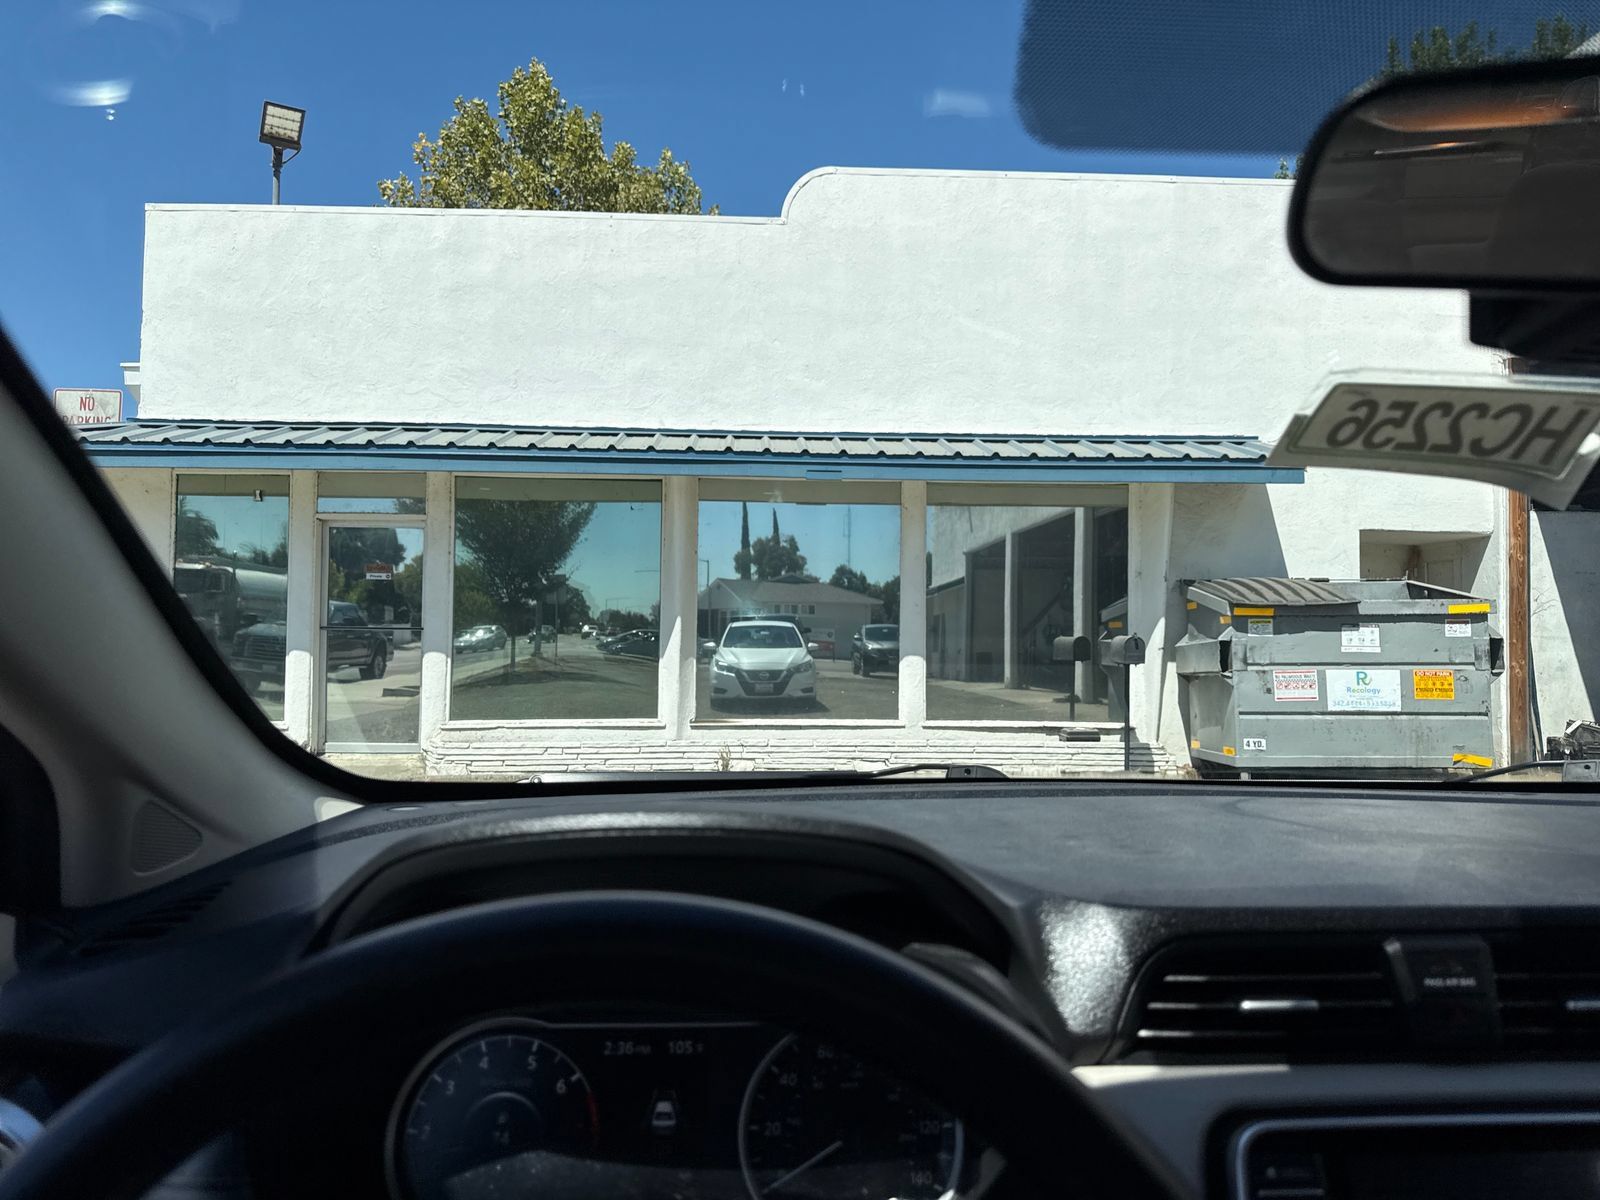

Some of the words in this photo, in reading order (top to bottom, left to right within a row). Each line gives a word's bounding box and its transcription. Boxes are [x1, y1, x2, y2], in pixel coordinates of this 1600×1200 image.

[80, 397, 94, 411] NO
[1346, 686, 1381, 694] Recology
[1245, 740, 1251, 748] 4
[603, 1041, 634, 1055] 2:36
[668, 1041, 693, 1054] 105
[478, 1056, 490, 1071] 4
[527, 1056, 538, 1071] 5
[444, 1080, 456, 1095] 3
[556, 1080, 567, 1095] 6
[764, 1121, 782, 1136] 20
